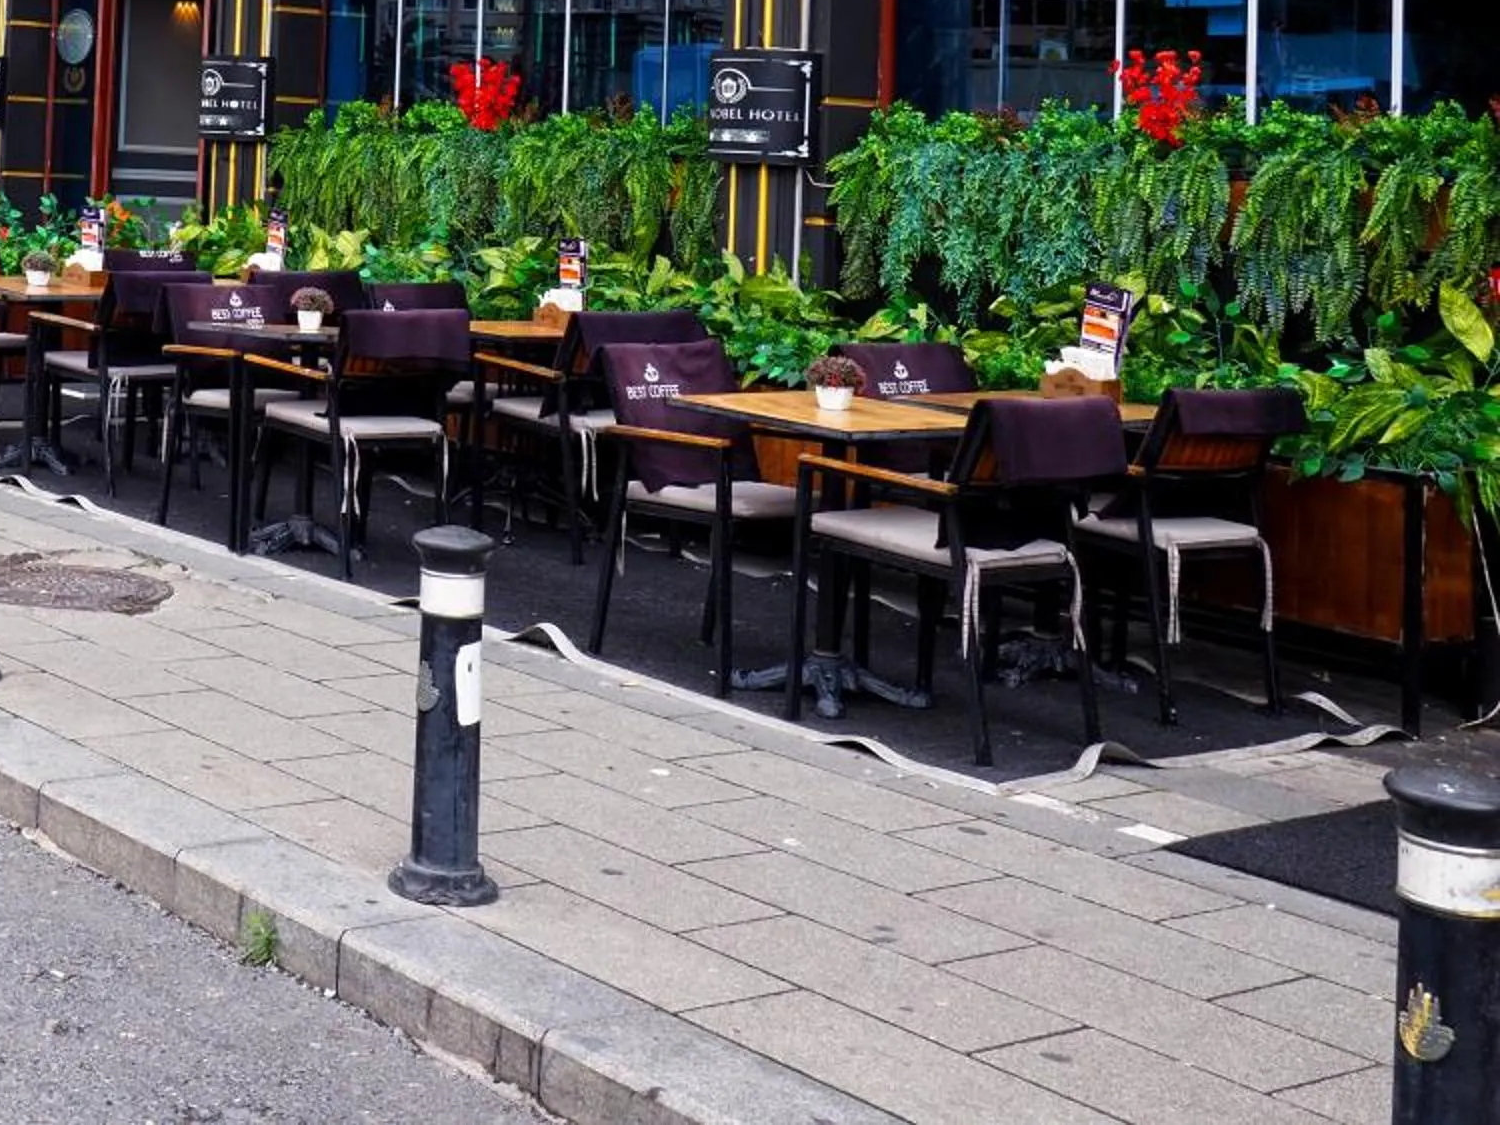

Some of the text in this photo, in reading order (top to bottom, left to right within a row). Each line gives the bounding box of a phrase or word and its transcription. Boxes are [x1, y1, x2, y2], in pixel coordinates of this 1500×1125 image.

[221, 100, 258, 110] HOTEL
[749, 109, 800, 122] HOTEL
[626, 384, 647, 400] BEST
